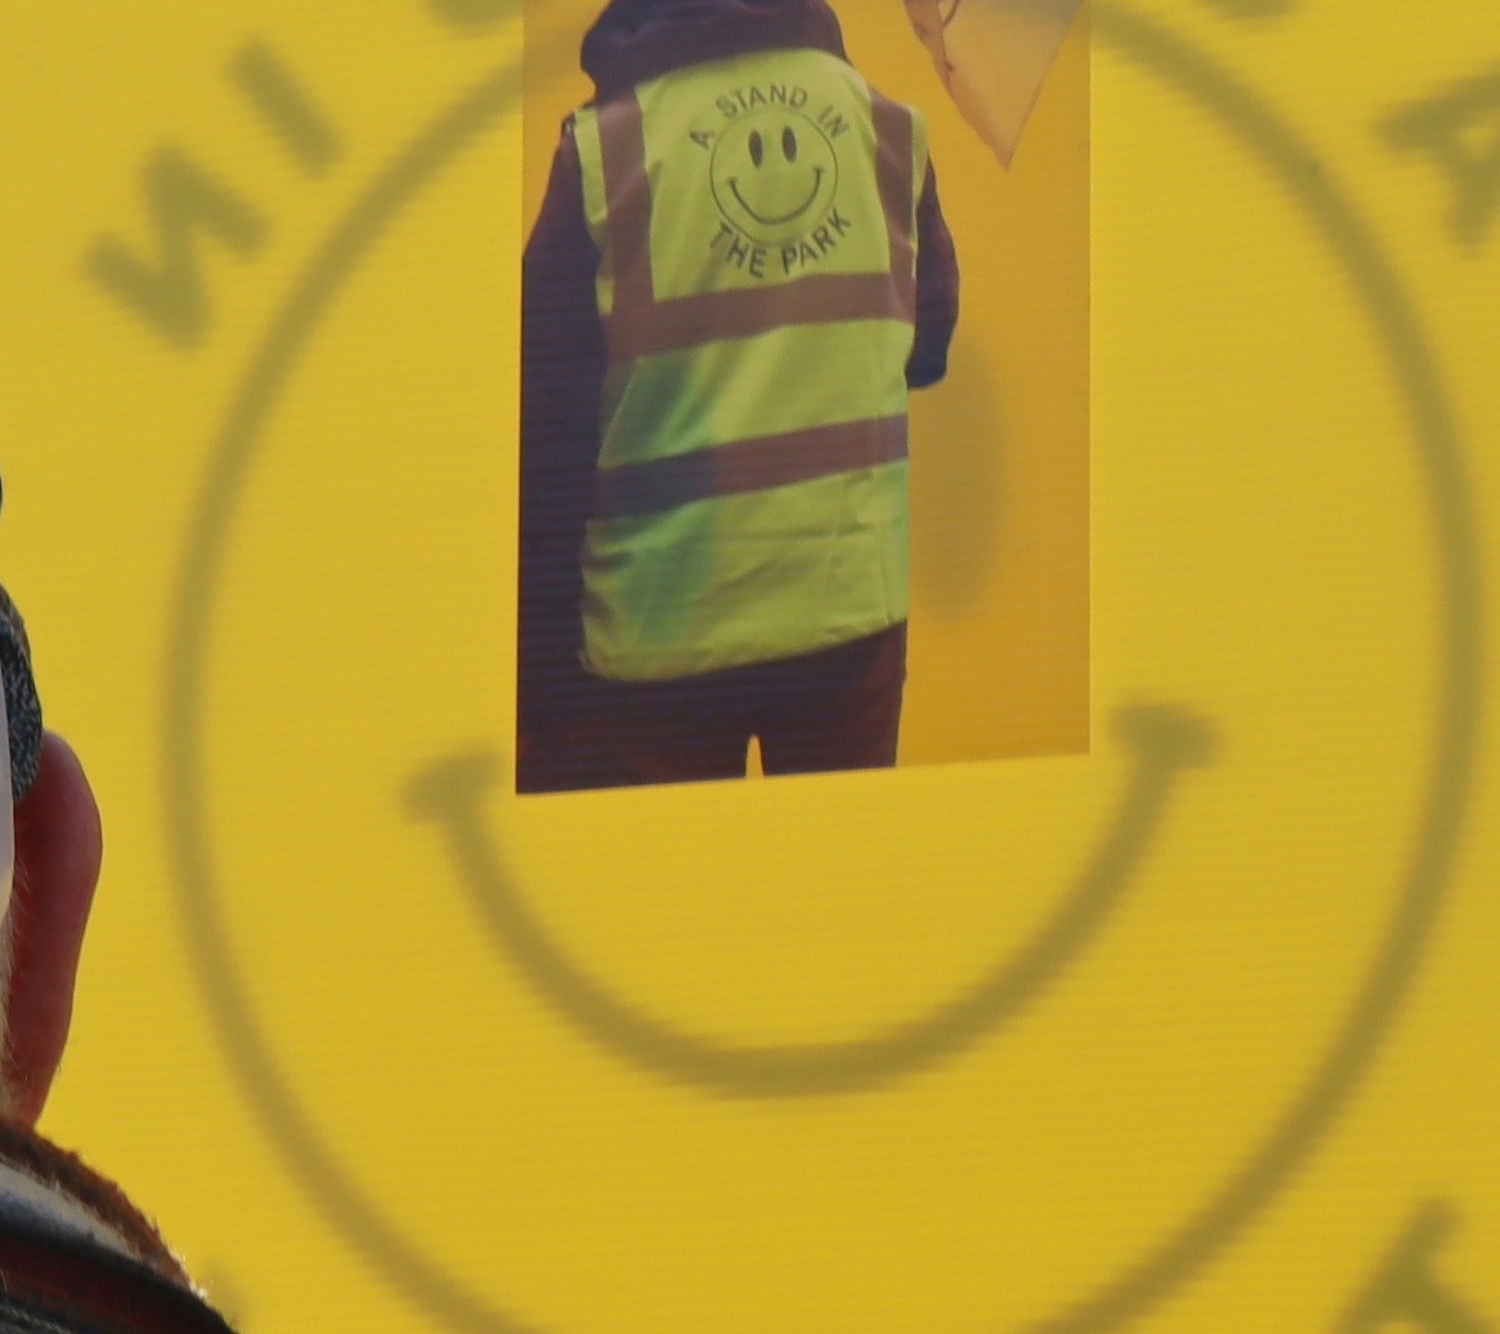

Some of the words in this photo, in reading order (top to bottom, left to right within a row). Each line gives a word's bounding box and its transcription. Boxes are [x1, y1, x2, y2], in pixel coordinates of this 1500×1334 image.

[689, 127, 715, 151] A
[715, 83, 808, 118] STAND
[818, 104, 850, 139] IN
[709, 220, 767, 279] THE
[780, 205, 852, 275] PARK
